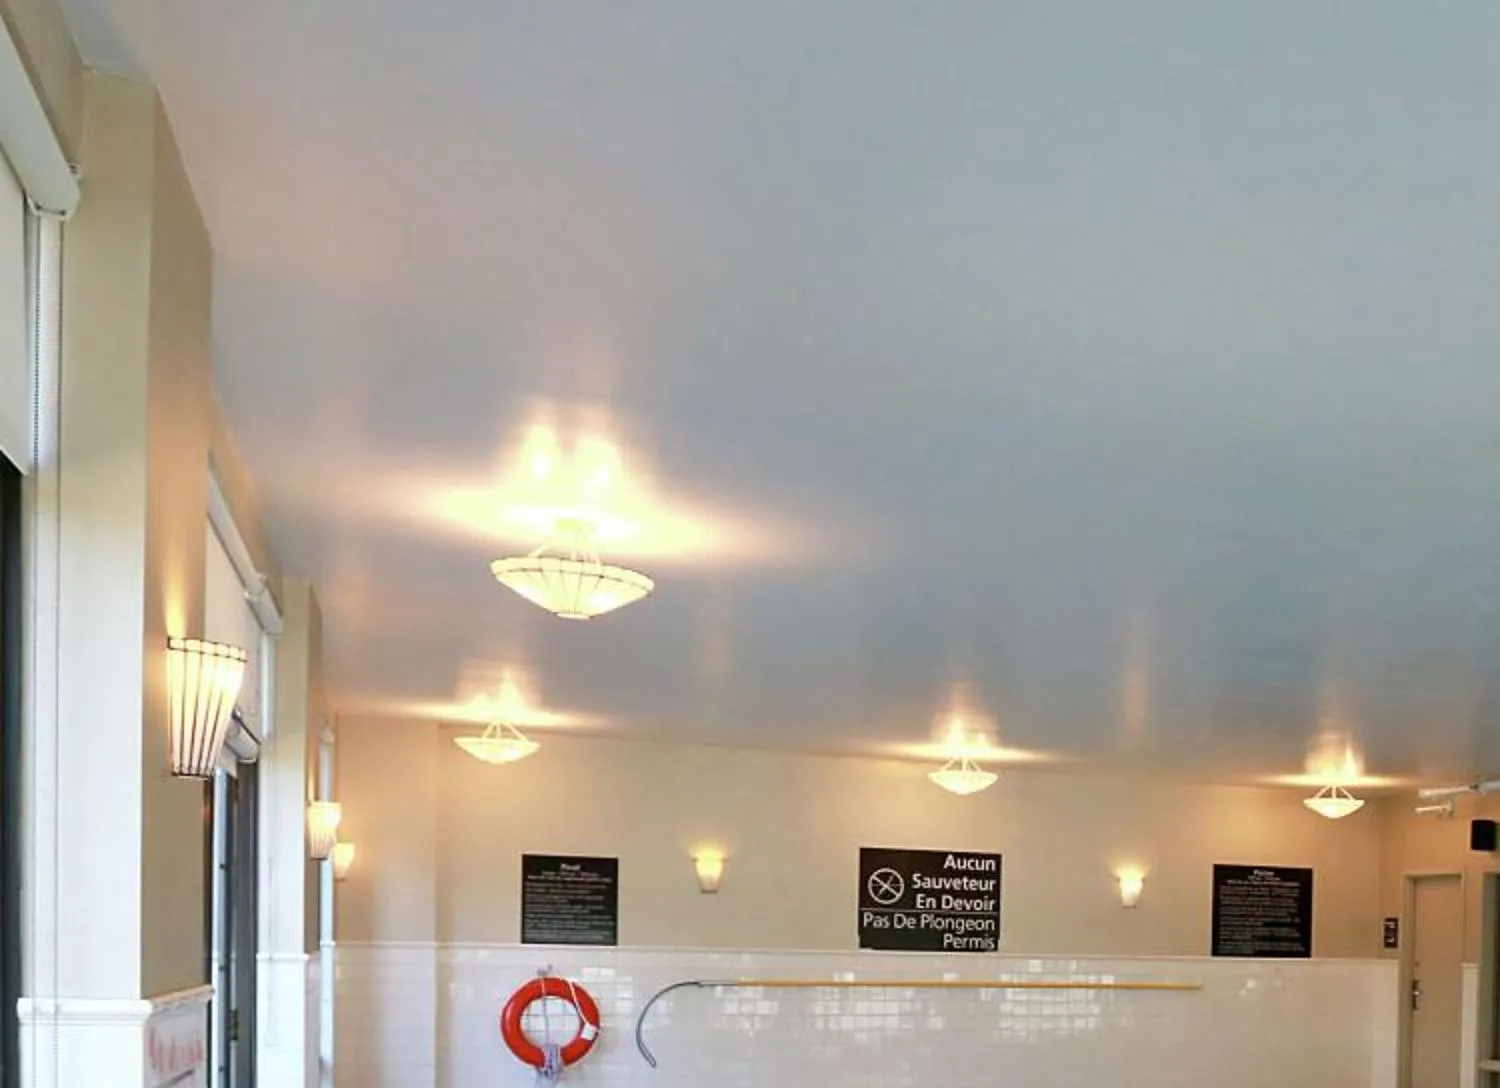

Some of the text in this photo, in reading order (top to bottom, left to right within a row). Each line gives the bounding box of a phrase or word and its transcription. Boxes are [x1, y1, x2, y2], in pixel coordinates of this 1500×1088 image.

[943, 854, 996, 871] Aucun
[912, 873, 996, 891] Sauveteur
[916, 893, 996, 911] En Devoir
[863, 912, 996, 934] Pas De Plongeon
[943, 933, 995, 949] Permis
